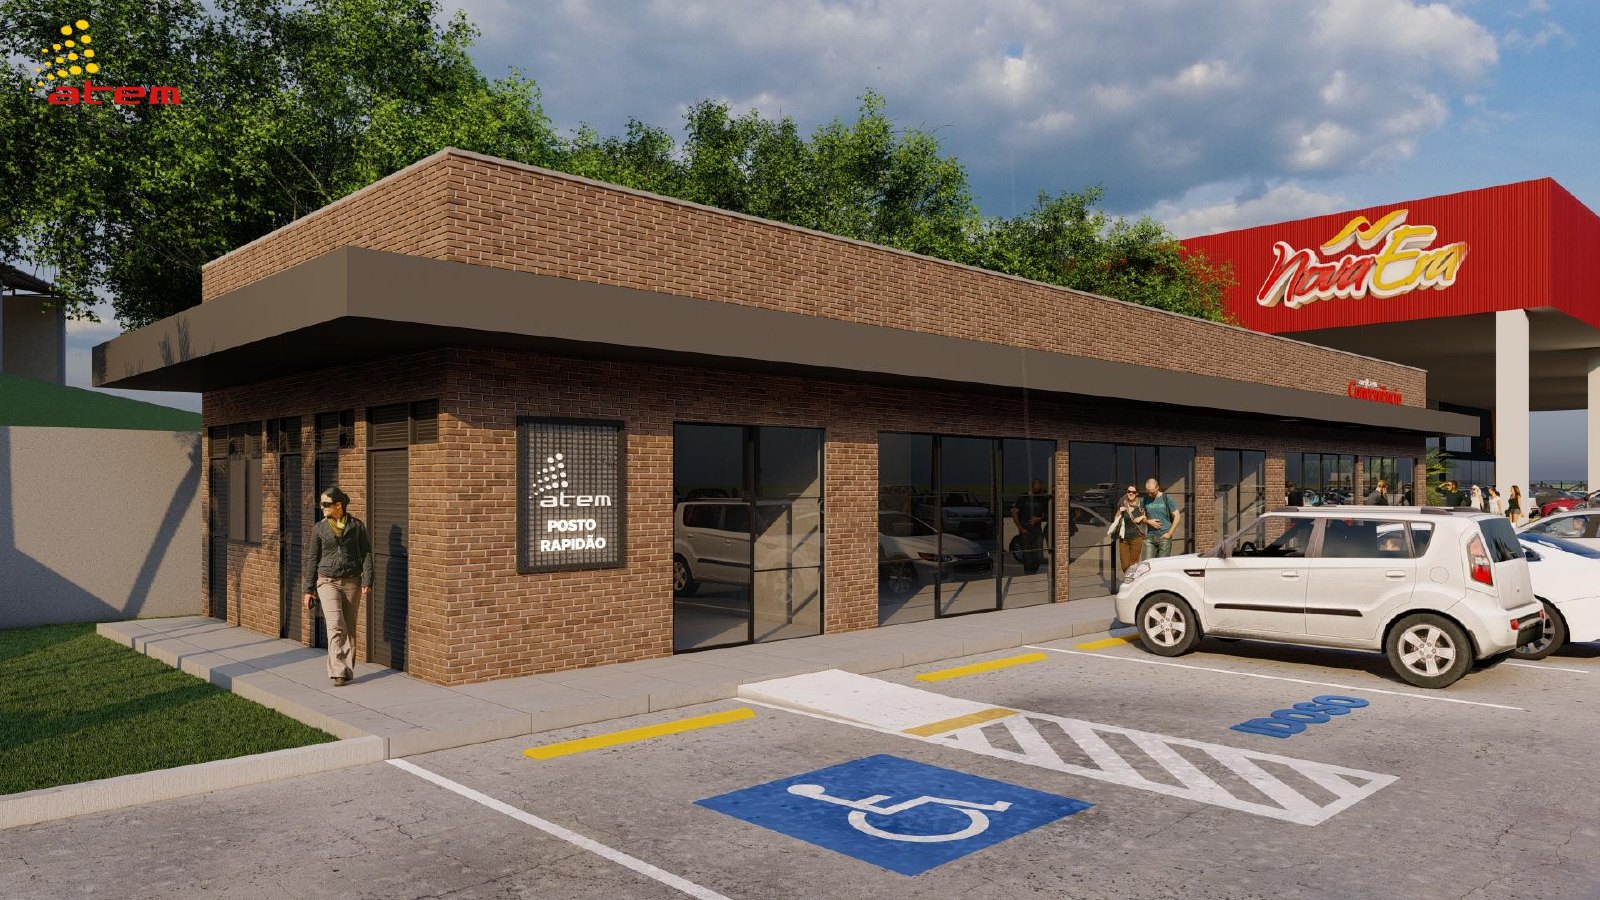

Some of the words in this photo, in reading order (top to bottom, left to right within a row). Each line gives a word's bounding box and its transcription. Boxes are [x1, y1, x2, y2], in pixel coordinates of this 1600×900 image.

[1257, 241, 1376, 309] Nova
[1371, 225, 1469, 298] Era
[540, 492, 612, 507] atem
[548, 519, 597, 532] POSTO
[540, 535, 606, 552] RAPIDÃO
[1229, 695, 1370, 739] IDOSO
